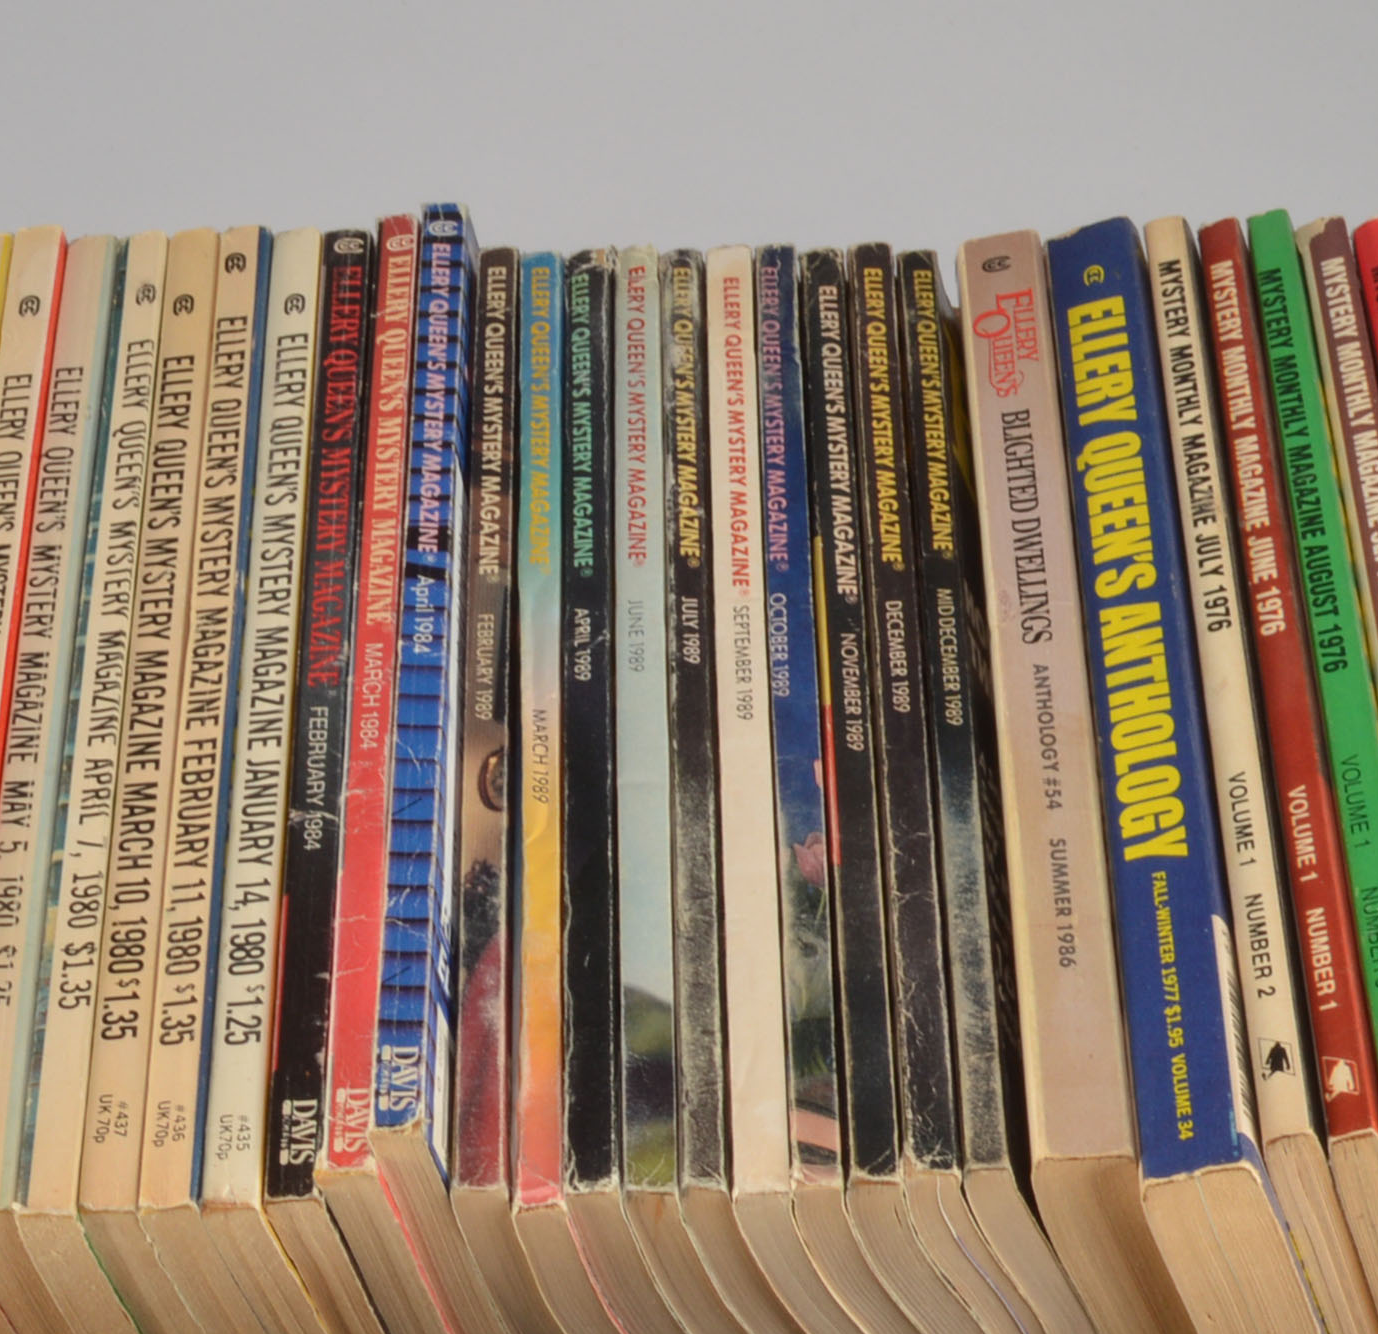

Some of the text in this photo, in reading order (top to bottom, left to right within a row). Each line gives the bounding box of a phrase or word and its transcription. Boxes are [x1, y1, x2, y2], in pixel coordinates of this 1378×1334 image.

[426, 243, 451, 298] ELLERY
[996, 288, 1039, 362] ELLERY
[273, 333, 309, 402] ELLERY
[423, 372, 446, 447] MYSTERY
[1158, 259, 1232, 633] MYSTERY MONTHLY MAGAZINE JULY 1976
[265, 415, 303, 506] QUEEN'S
[418, 450, 443, 553] MAGAZINE
[723, 277, 753, 721] ELLERY QUEEN'S MYSTERY MAGAZINE SEPTEMBER 1989
[1002, 409, 1052, 644] BLIGHTED DWELLINGS
[257, 512, 295, 617] MYSTERY
[414, 575, 435, 616] April
[1068, 295, 1188, 861] ELLERY QUEEN'S ANTHOLOGY
[413, 619, 433, 654] 1984
[248, 625, 289, 751] MAGAZINE
[238, 759, 281, 867] JANUARY
[1033, 664, 1076, 968] ANTHOLOGY #54 SUMMER 1986
[1228, 771, 1276, 999] VOLUME 1 NUMBER 2
[227, 918, 267, 976] 1980
[1162, 967, 1180, 1001] 1977
[225, 984, 264, 1046] $1.25
[1163, 1005, 1183, 1048] $1.95
[1171, 1053, 1192, 1118] VOLUME
[1177, 1120, 1193, 1140] 34
